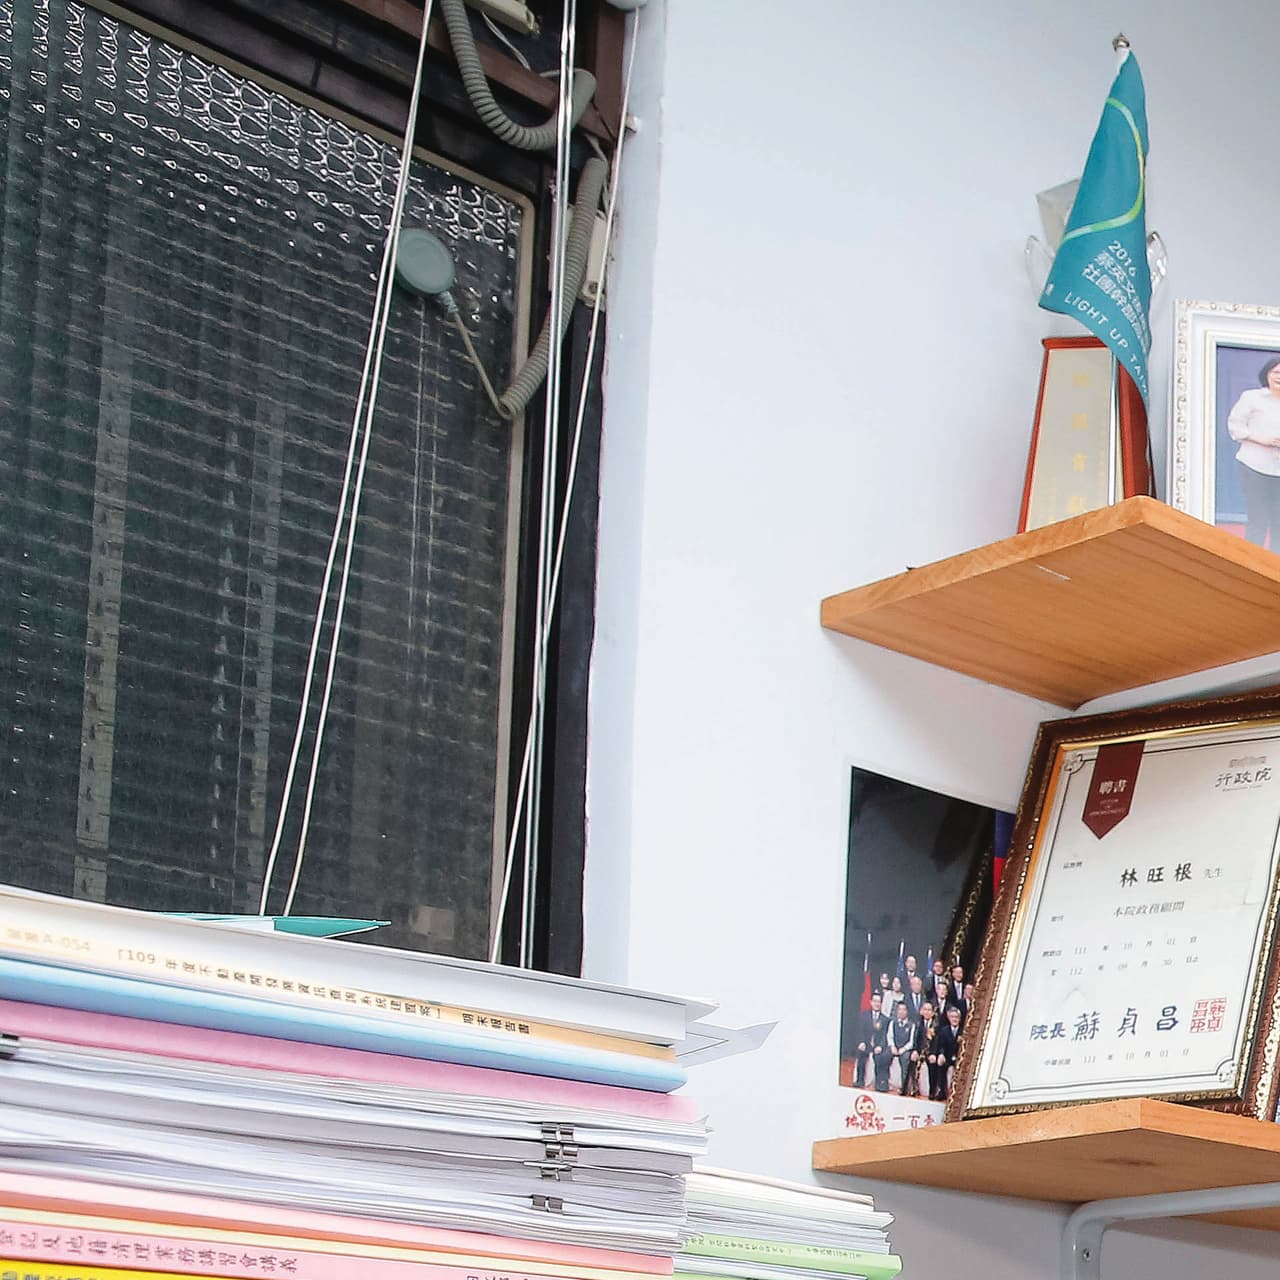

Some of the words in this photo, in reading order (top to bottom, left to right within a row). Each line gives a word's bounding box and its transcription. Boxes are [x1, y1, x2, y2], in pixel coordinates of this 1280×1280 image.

[1108, 240, 1137, 277] 2016
[1064, 292, 1108, 325] LIGHT
[1109, 328, 1128, 348] UP
[1215, 768, 1272, 787] 行政院
[1120, 862, 1192, 888] 林旺根
[461, 1012, 530, 1035] 期末報告書
[1029, 1021, 1067, 1041] 院長
